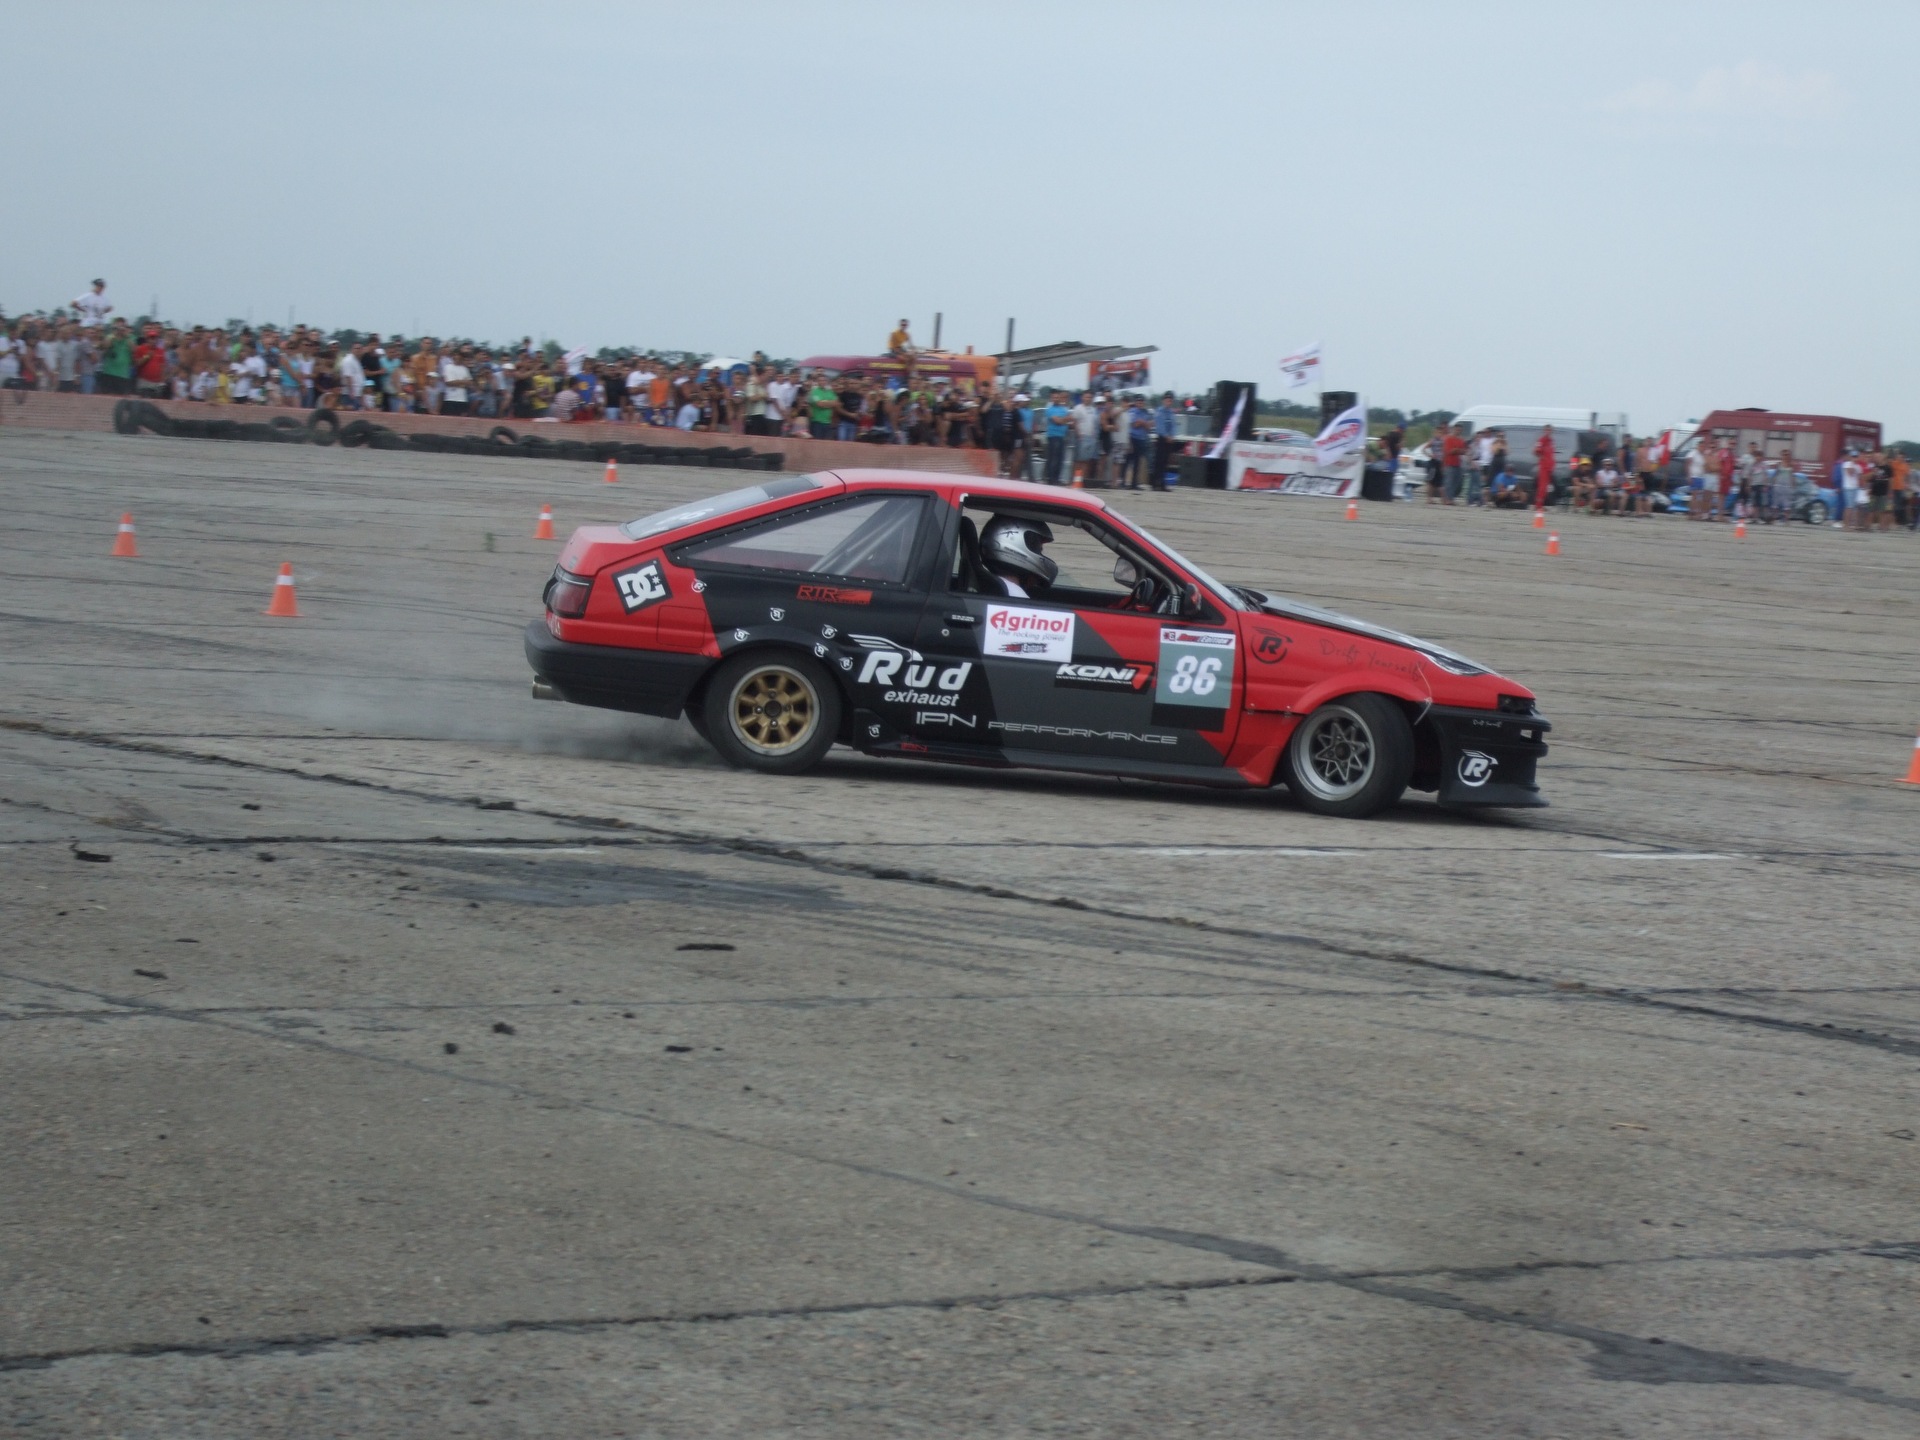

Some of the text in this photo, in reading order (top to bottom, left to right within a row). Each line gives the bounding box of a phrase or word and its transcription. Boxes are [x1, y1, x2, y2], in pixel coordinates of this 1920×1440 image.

[617, 565, 666, 608] DC
[797, 585, 838, 599] RTR
[990, 610, 1070, 633] Agrinol
[998, 629, 1011, 637] The
[857, 650, 972, 691] Rud
[1056, 663, 1136, 681] KONI
[1169, 655, 1223, 696] 86
[884, 689, 959, 706] exhaust
[916, 711, 976, 728] IPN
[988, 721, 1178, 745] PERFORMANCE
